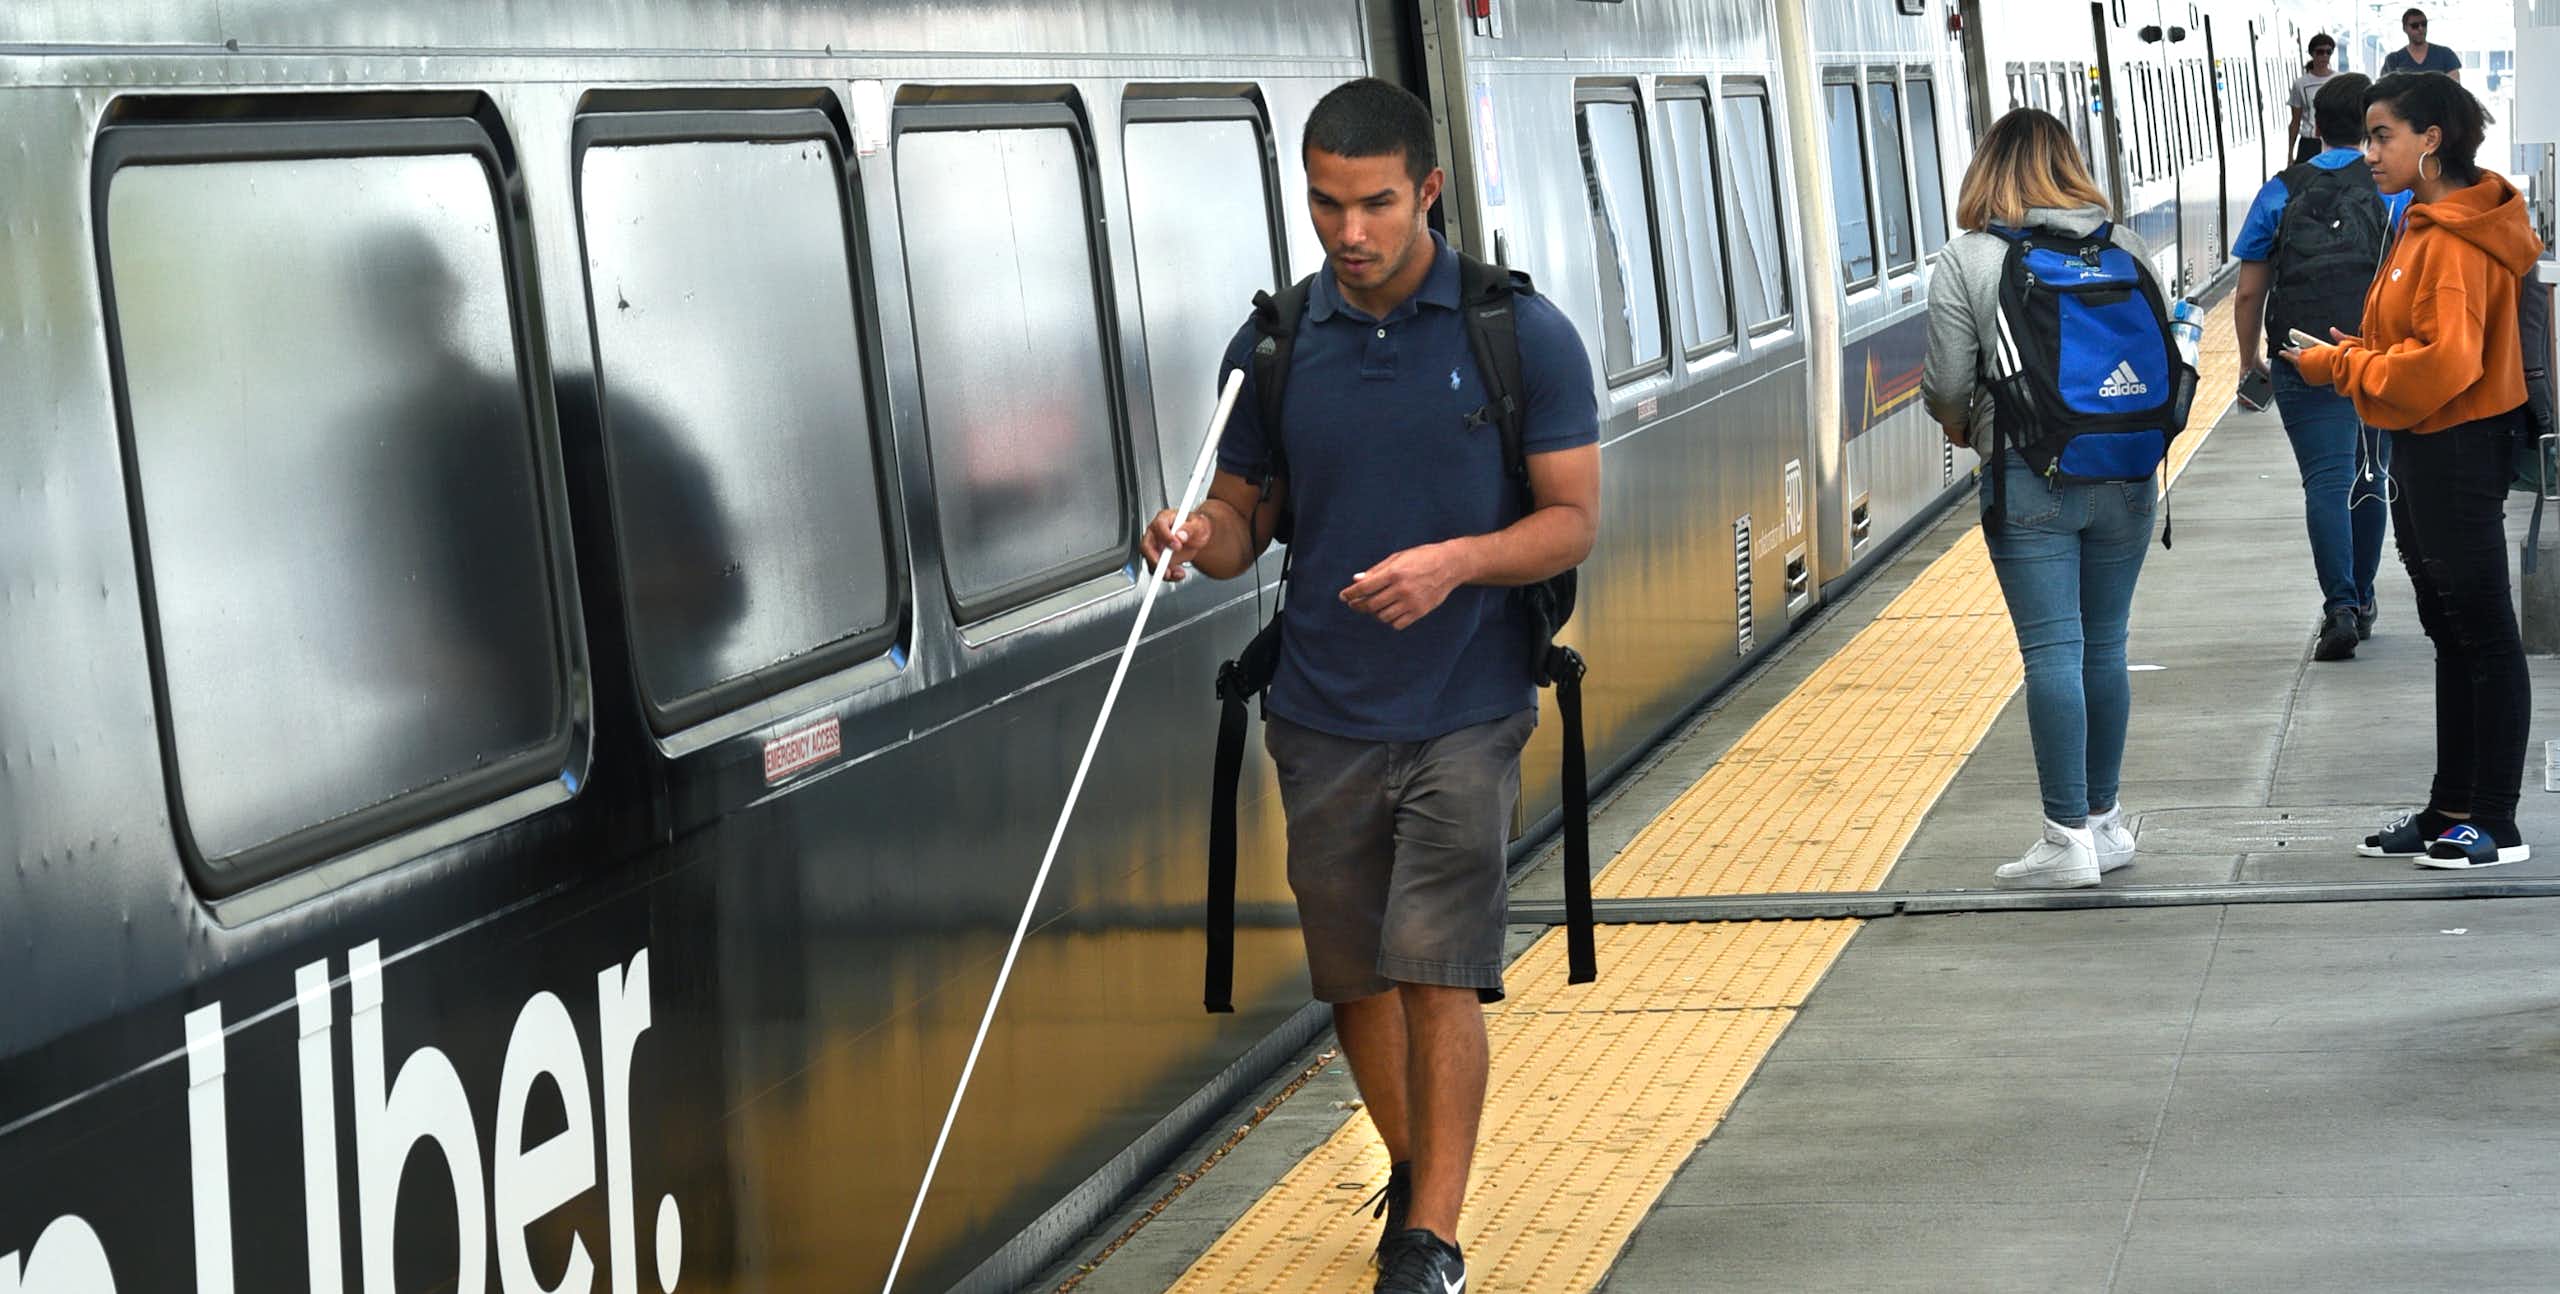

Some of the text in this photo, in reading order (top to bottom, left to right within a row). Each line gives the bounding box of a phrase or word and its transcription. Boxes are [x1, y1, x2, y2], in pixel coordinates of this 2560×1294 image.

[2099, 383, 2147, 397] adidas
[1785, 466, 1803, 541] RTD
[766, 723, 839, 772] EMERGENCY ACCESS
